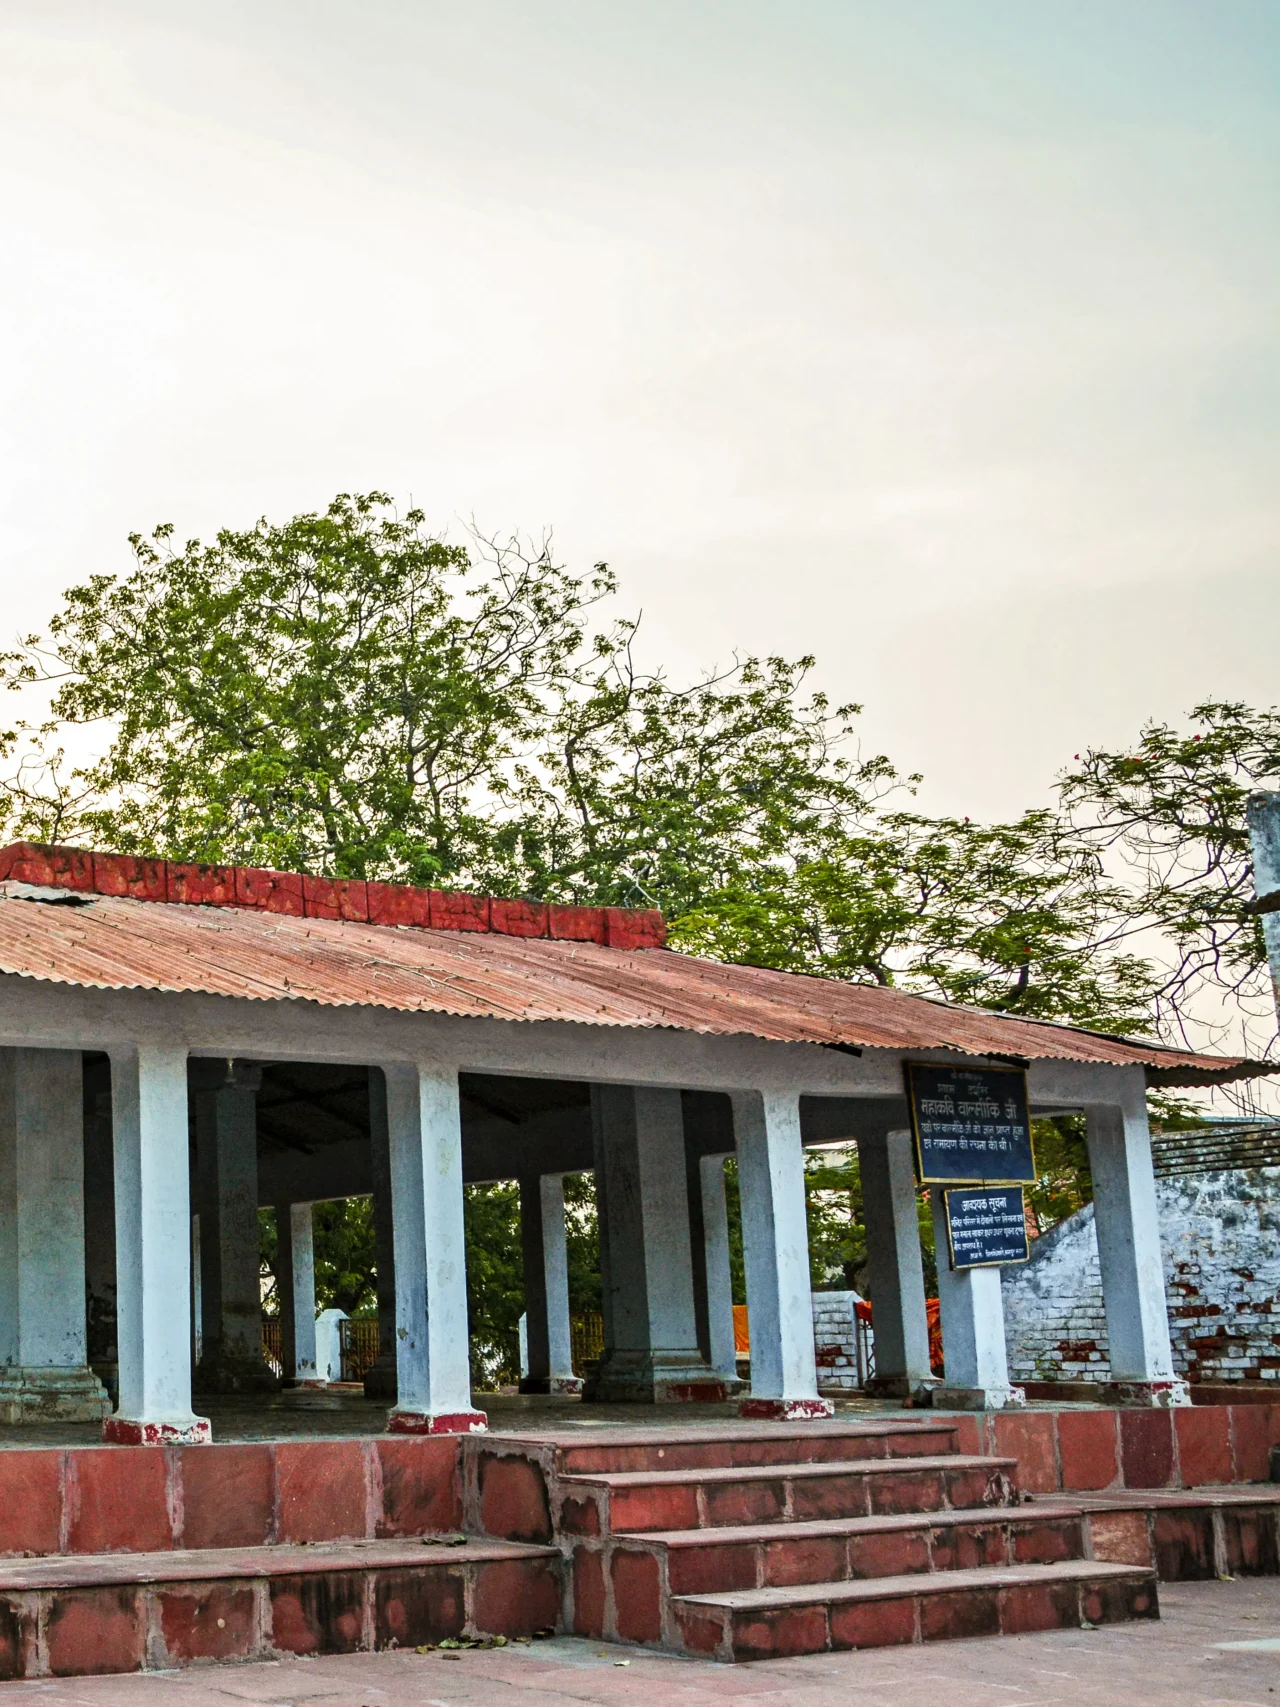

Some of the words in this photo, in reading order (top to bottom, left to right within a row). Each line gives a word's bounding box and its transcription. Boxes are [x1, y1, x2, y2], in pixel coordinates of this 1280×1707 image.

[920, 1094, 955, 1117] महाकवि
[957, 1096, 1000, 1118] वाल्मीकि
[1004, 1097, 1018, 1119] जी
[972, 1120, 981, 1134] को
[995, 1125, 1011, 1135] प्राप्त
[933, 1139, 958, 1150] रामायण
[958, 1135, 969, 1150] की
[969, 1139, 987, 1151] रचना
[987, 1136, 998, 1151] की
[961, 1198, 987, 1212] आवश्यक
[988, 1197, 1007, 1213] सूचना
